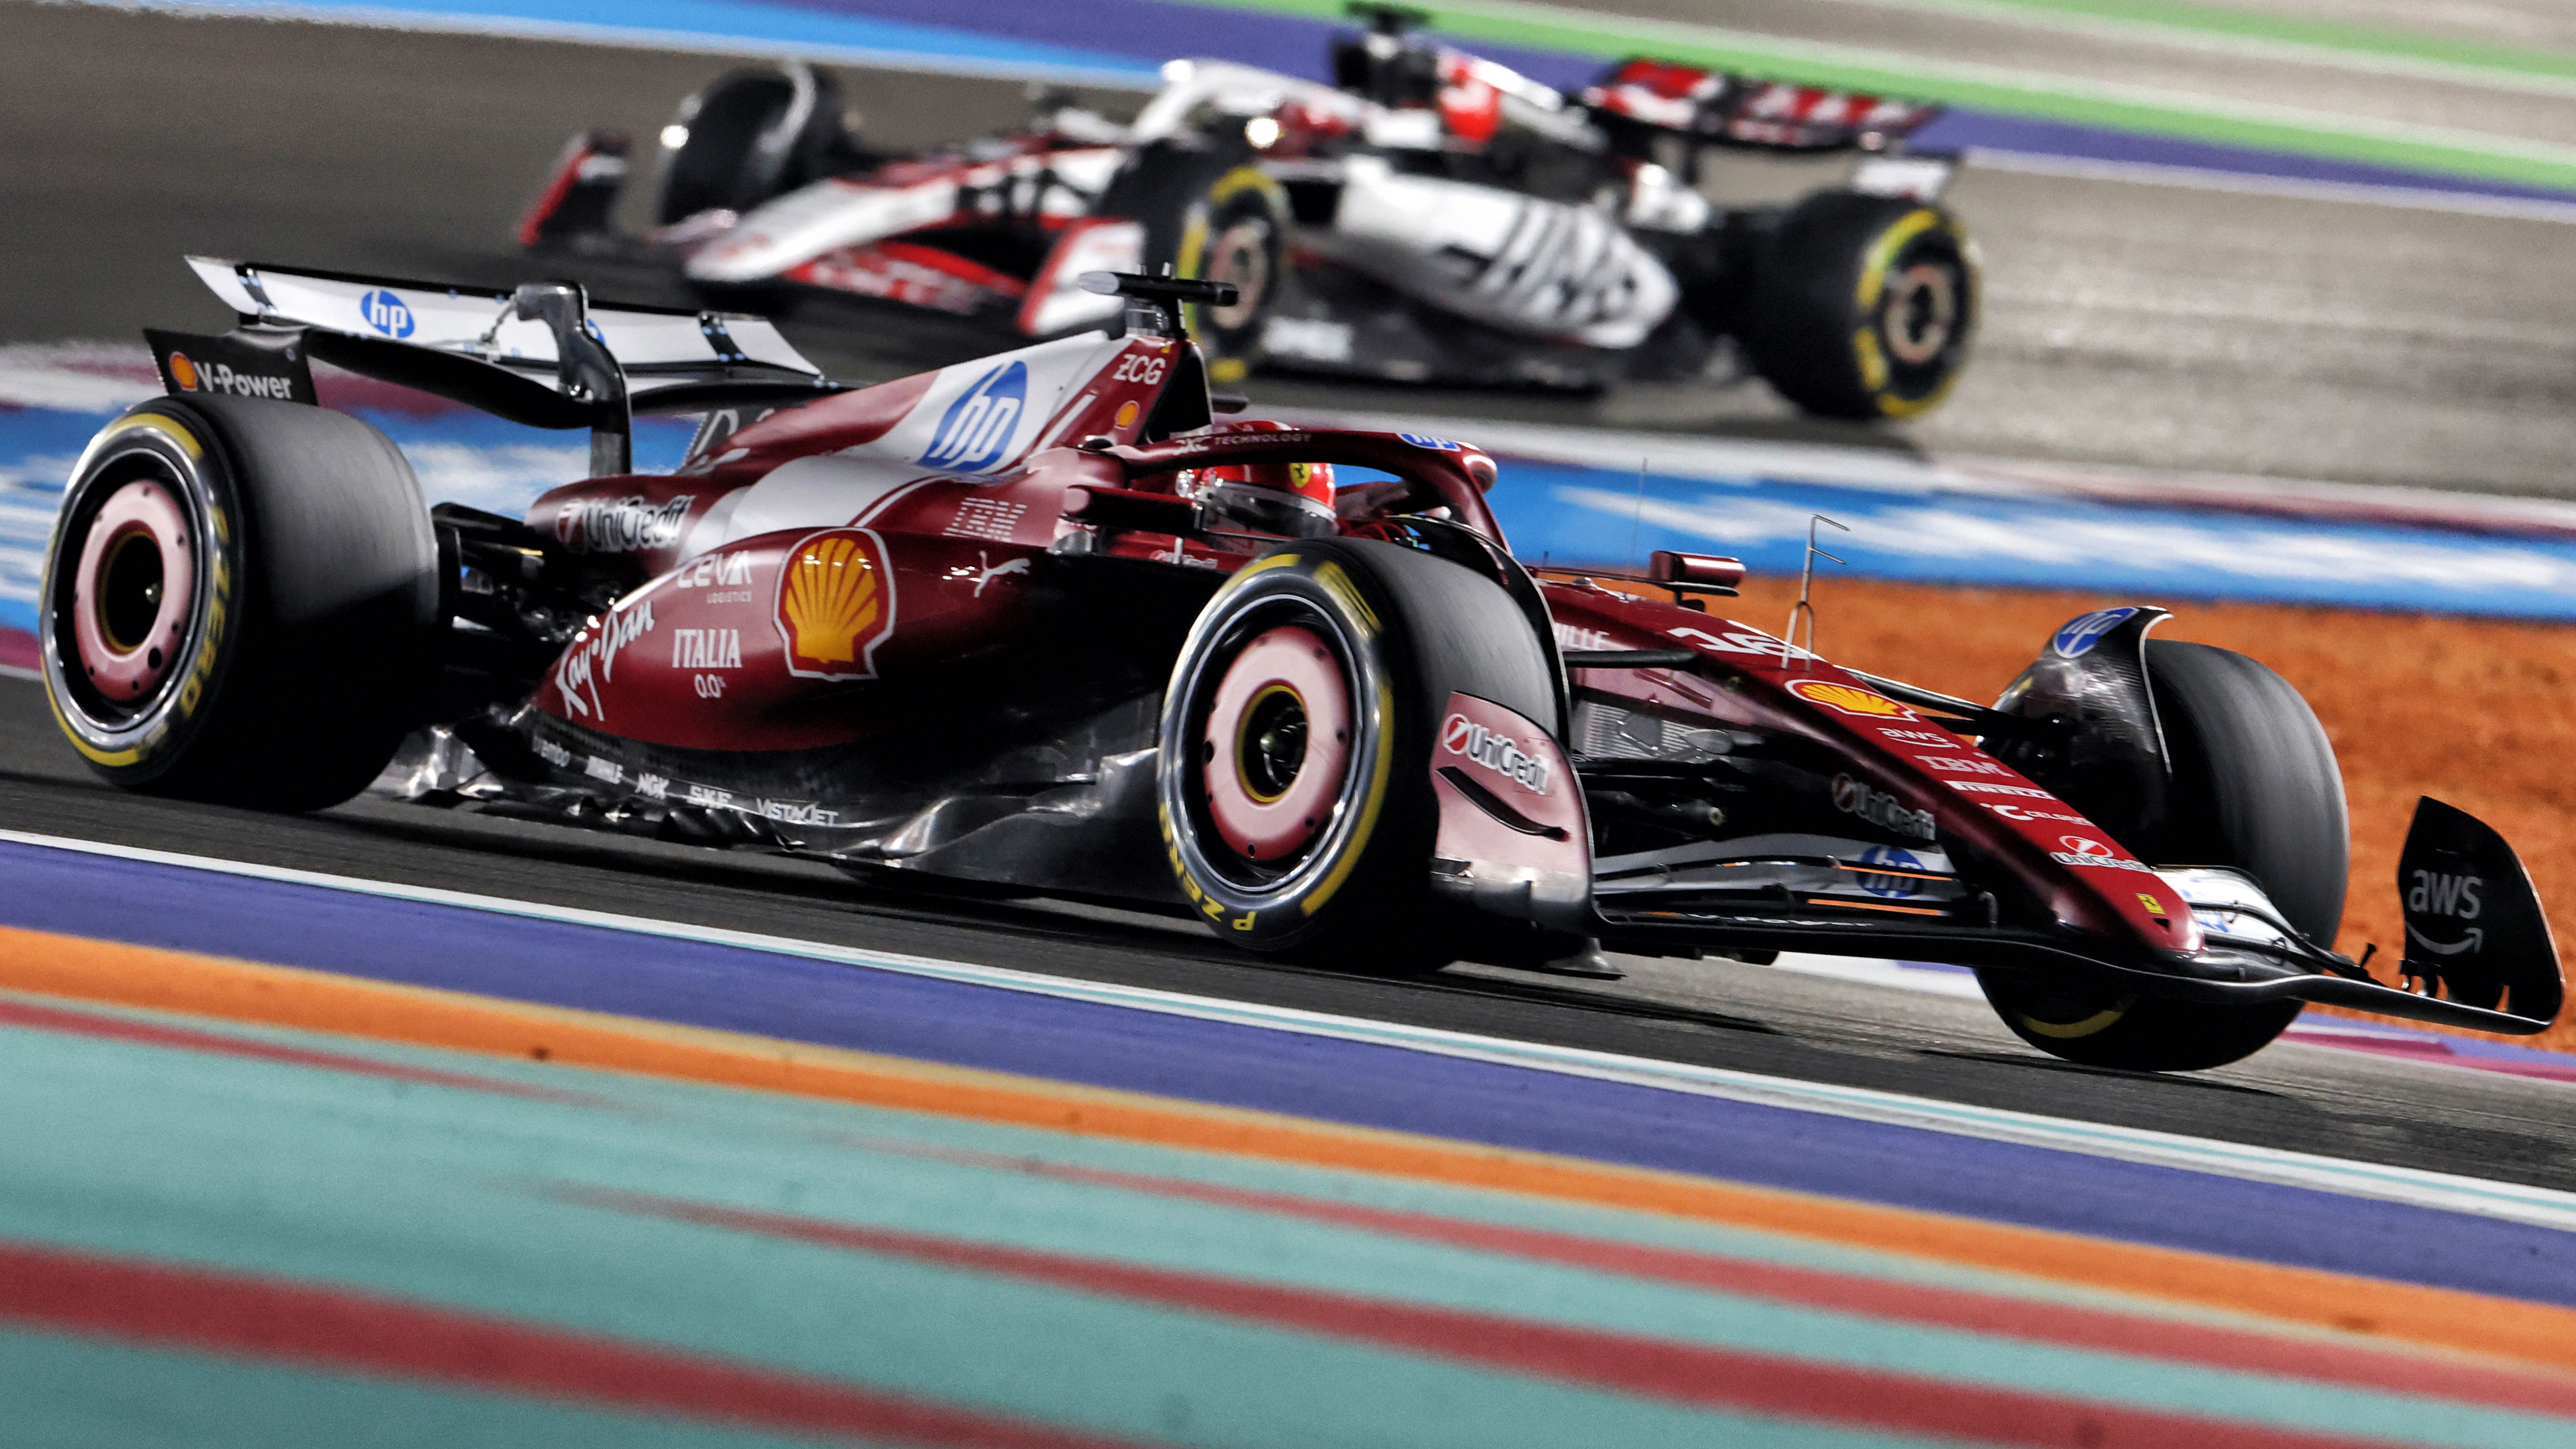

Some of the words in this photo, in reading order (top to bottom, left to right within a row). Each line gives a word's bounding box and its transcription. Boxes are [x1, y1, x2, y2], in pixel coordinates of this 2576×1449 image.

[370, 290, 407, 338] hp
[193, 361, 293, 399] V-Power
[1113, 354, 1166, 385] ZCG
[931, 362, 1020, 471] hp
[941, 497, 1028, 542] IBM
[673, 628, 742, 668] ITALIA
[1666, 627, 1814, 660] 16
[1876, 727, 1949, 743] aws
[1467, 723, 1551, 795] UniCredit
[1913, 755, 2015, 778] IBM
[2409, 870, 2482, 919] aws
[1232, 911, 1257, 931] P
